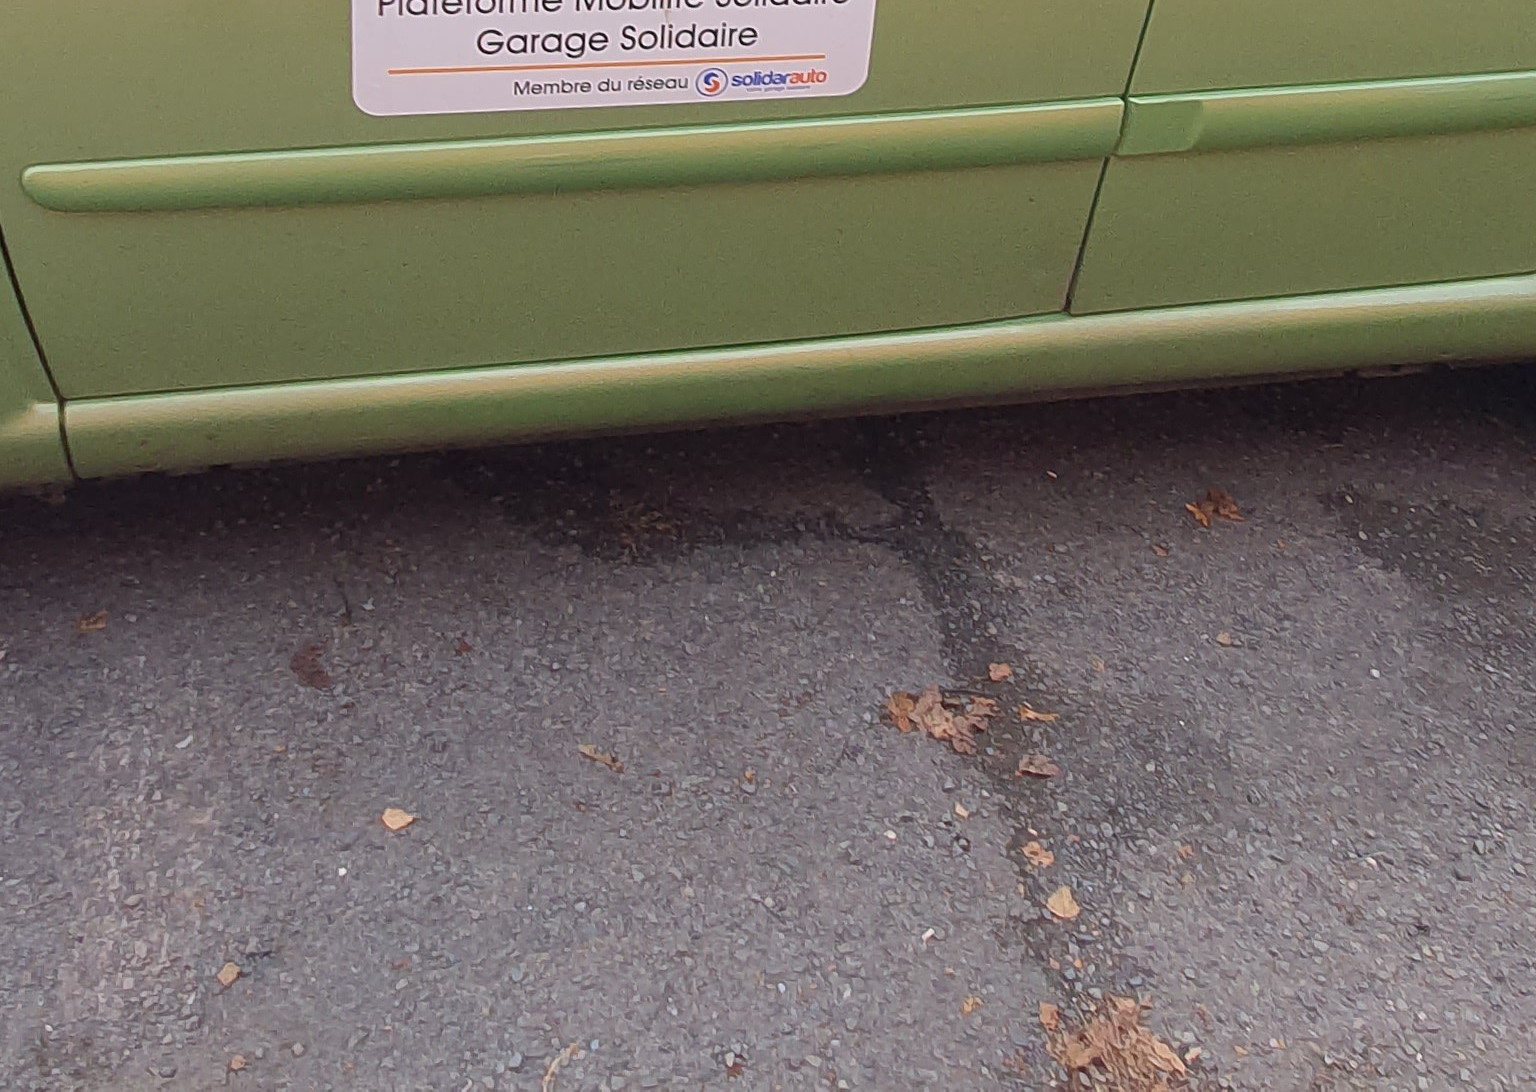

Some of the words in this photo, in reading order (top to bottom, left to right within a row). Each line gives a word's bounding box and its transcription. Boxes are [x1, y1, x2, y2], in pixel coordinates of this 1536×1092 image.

[476, 29, 609, 58] Garage
[620, 22, 758, 51] Solidaire
[513, 79, 592, 96] Membre
[598, 77, 621, 92] du
[627, 75, 689, 91] réseau
[731, 68, 828, 87] solidarauto
